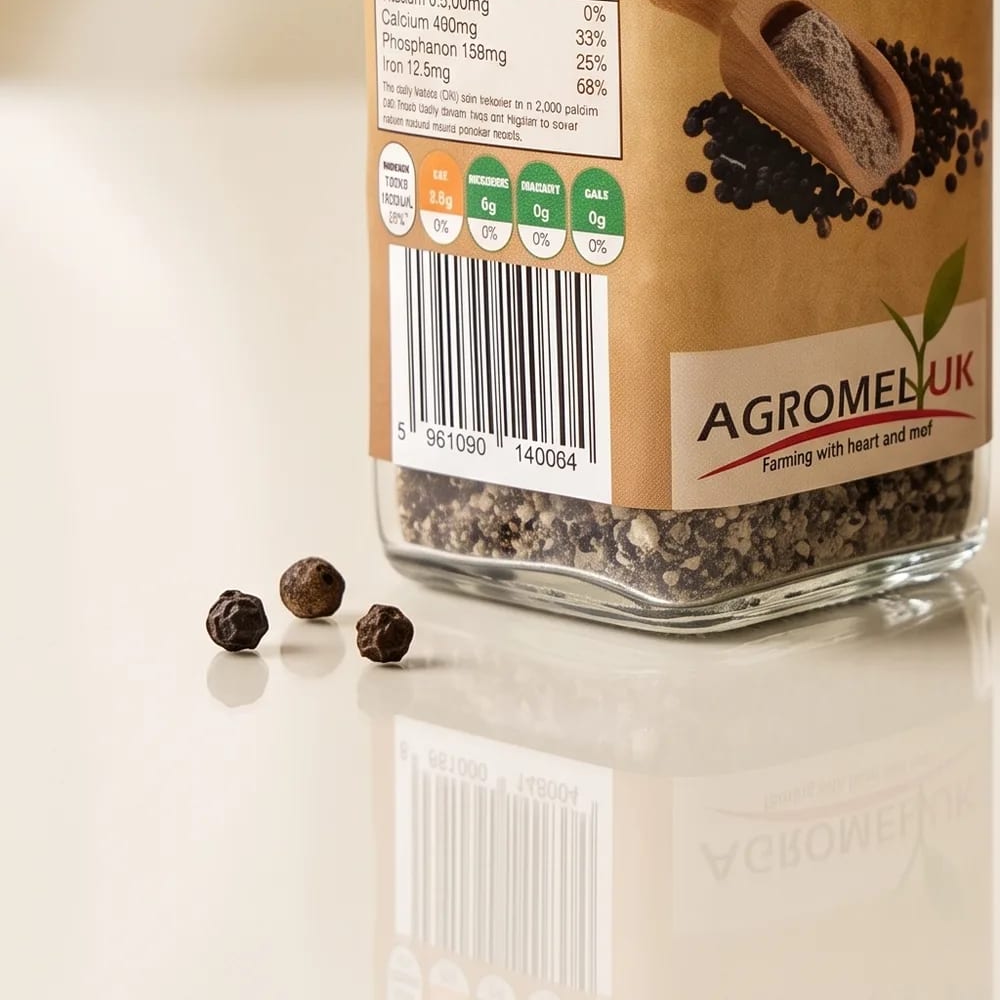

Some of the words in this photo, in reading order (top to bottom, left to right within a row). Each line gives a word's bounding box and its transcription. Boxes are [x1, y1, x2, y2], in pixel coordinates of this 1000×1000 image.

[583, 5, 606, 23] 0%
[382, 9, 429, 30] Calcium
[575, 29, 607, 48] 33%
[576, 54, 608, 72] 25%
[383, 55, 404, 74] Iron
[407, 59, 451, 83] 12.5mg
[576, 78, 608, 96] 68%
[535, 100, 562, 114] 2,000
[481, 197, 497, 216] 6g
[533, 204, 550, 223] 0g
[434, 218, 449, 234] 0%
[588, 210, 606, 230] 0g
[481, 225, 498, 241] 0%
[532, 231, 551, 247] 0%
[588, 238, 608, 254] 0%
[696, 367, 917, 442] AGROMEL
[929, 351, 975, 396] UK
[397, 422, 406, 440] 5
[426, 428, 486, 456] 961090
[515, 444, 577, 471] 140064
[762, 451, 813, 473] Farming
[816, 440, 844, 461] with
[848, 433, 879, 453] heart
[883, 425, 905, 446] and
